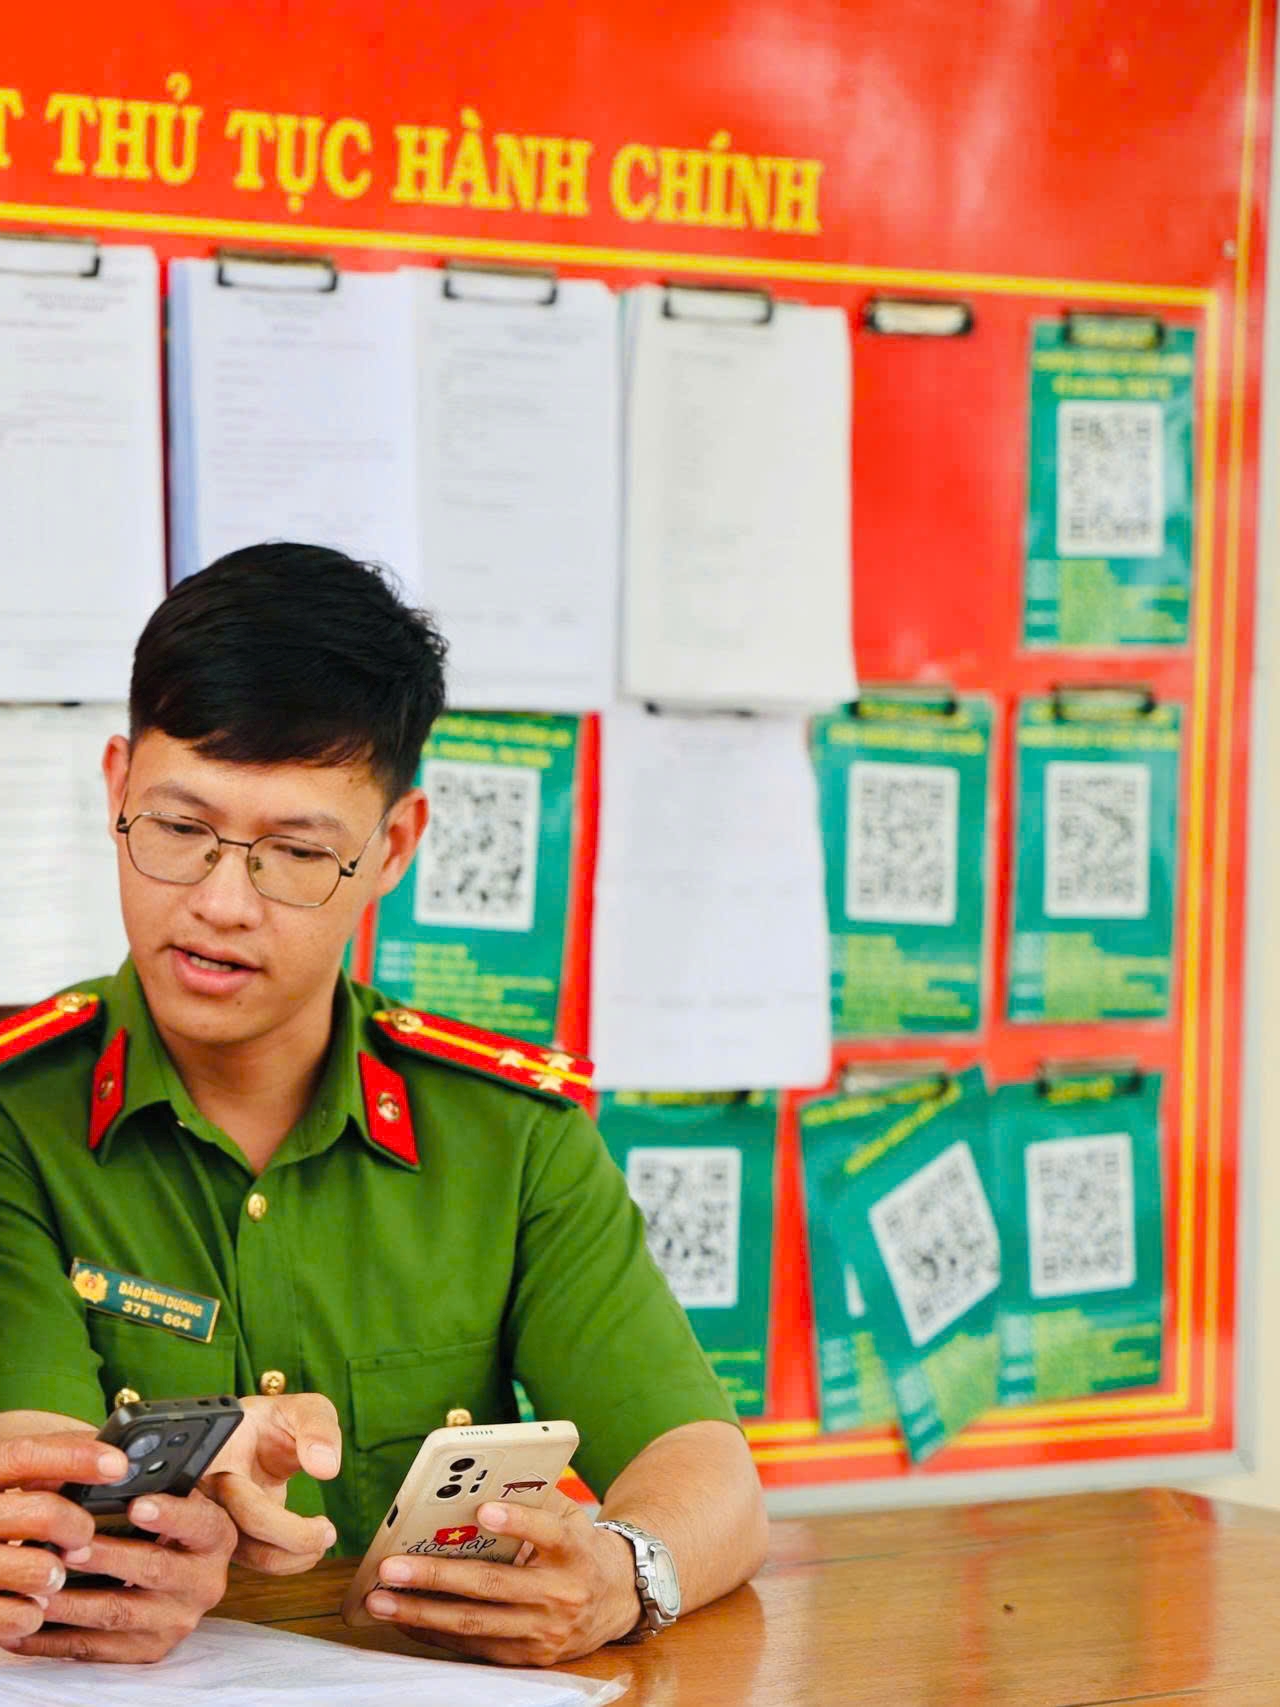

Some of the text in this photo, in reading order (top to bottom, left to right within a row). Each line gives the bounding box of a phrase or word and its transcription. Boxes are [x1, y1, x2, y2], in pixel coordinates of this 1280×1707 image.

[45, 73, 203, 184] THỦ
[226, 110, 371, 213] TỤC
[392, 109, 592, 216] HÀNH
[611, 132, 824, 234] CHÍNH
